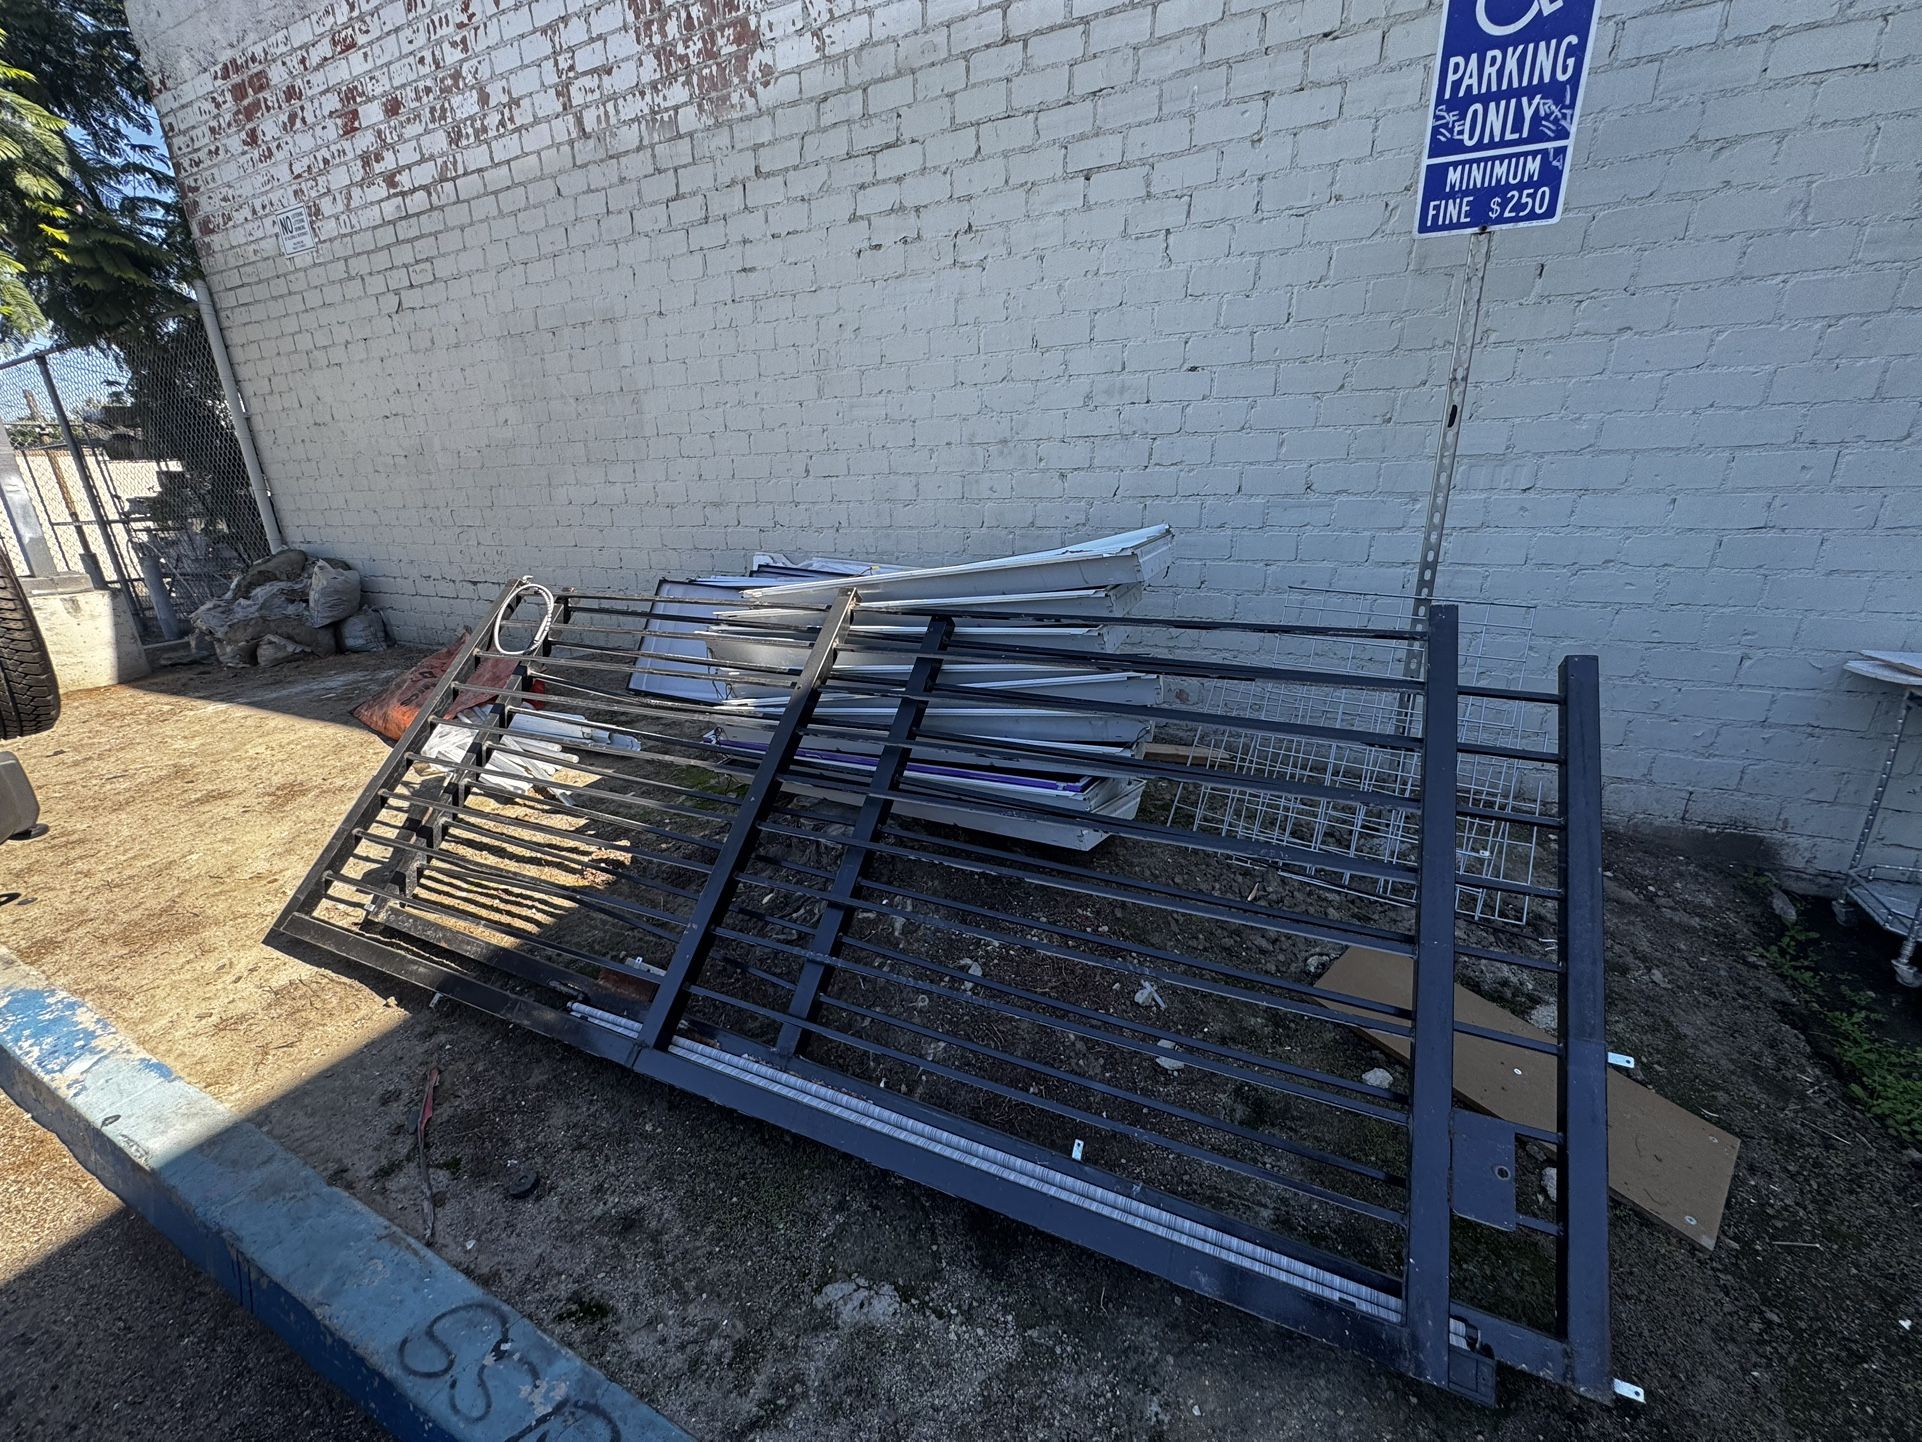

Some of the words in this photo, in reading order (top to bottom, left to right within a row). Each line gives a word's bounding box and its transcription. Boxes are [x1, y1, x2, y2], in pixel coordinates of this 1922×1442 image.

[1444, 34, 1579, 100] PARKING
[1463, 94, 1542, 147] ONLY
[1445, 154, 1542, 193] MINIMUM
[279, 215, 294, 236] NO
[1426, 196, 1474, 227] FINE
[1488, 186, 1550, 219] $250
